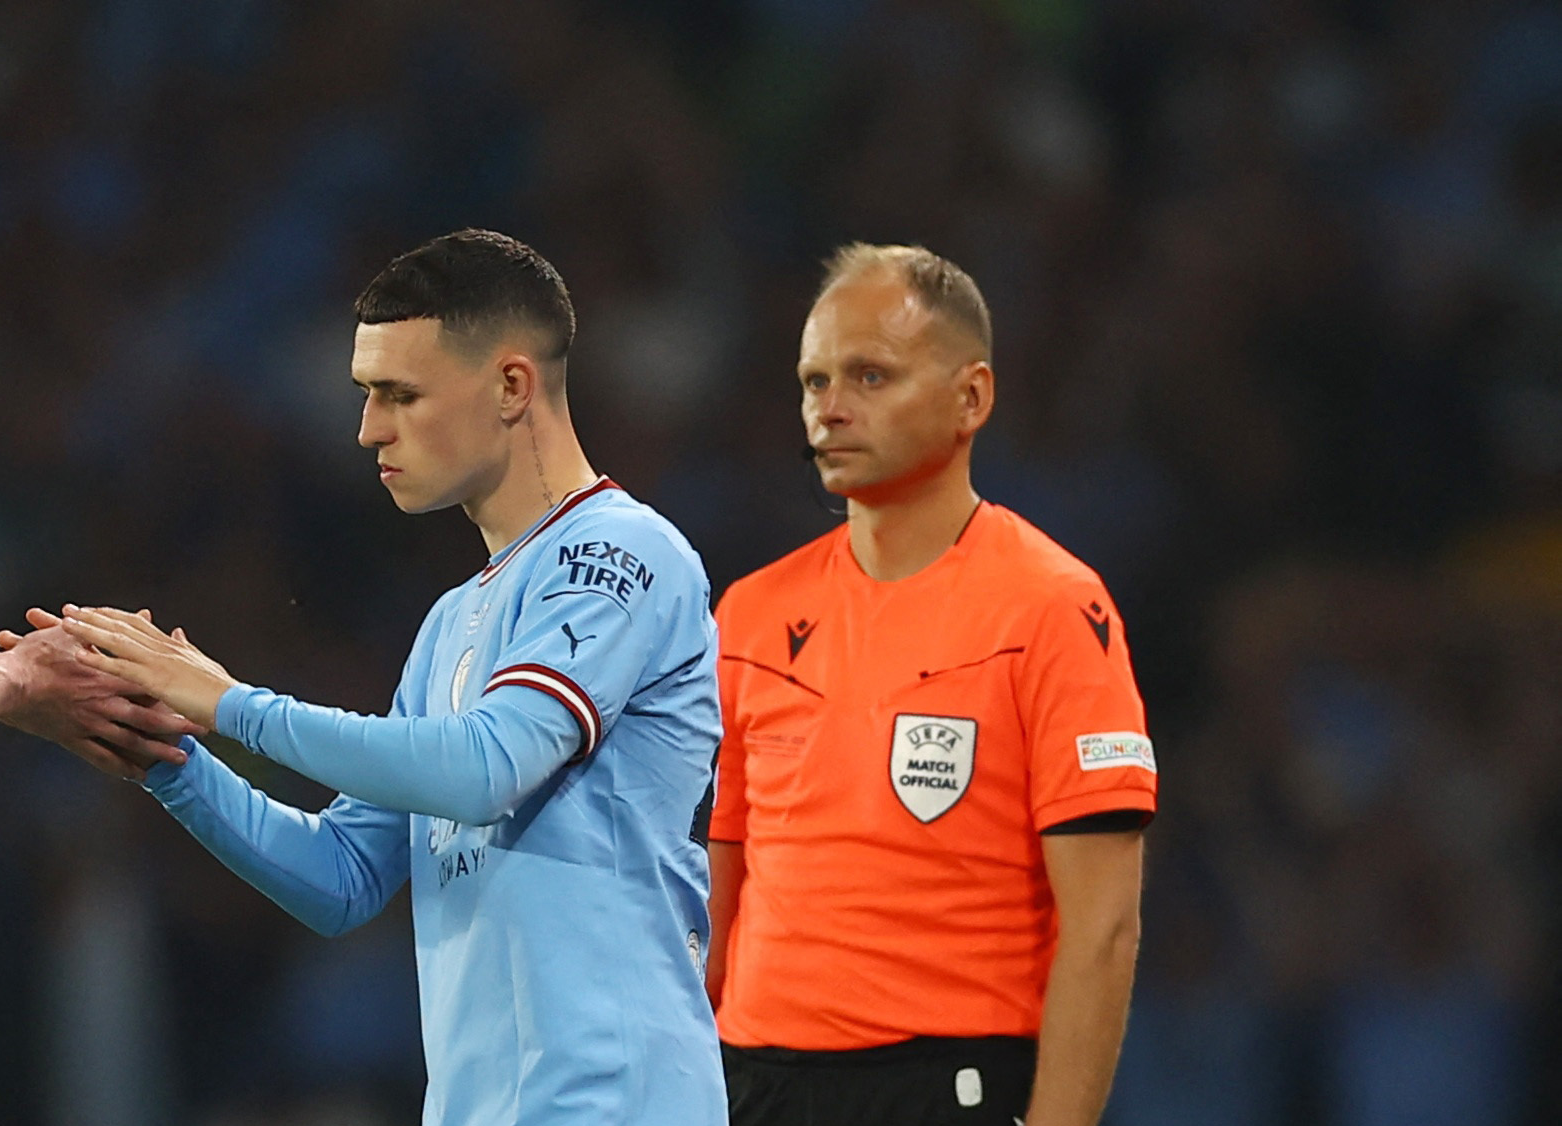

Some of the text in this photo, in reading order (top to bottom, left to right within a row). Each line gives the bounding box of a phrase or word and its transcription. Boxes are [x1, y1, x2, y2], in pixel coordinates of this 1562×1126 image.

[558, 541, 655, 593] NEXEN
[566, 561, 634, 605] TIRE
[906, 727, 957, 749] UEFA
[907, 758, 956, 774] MATCH
[899, 774, 958, 791] OFFICIAL
